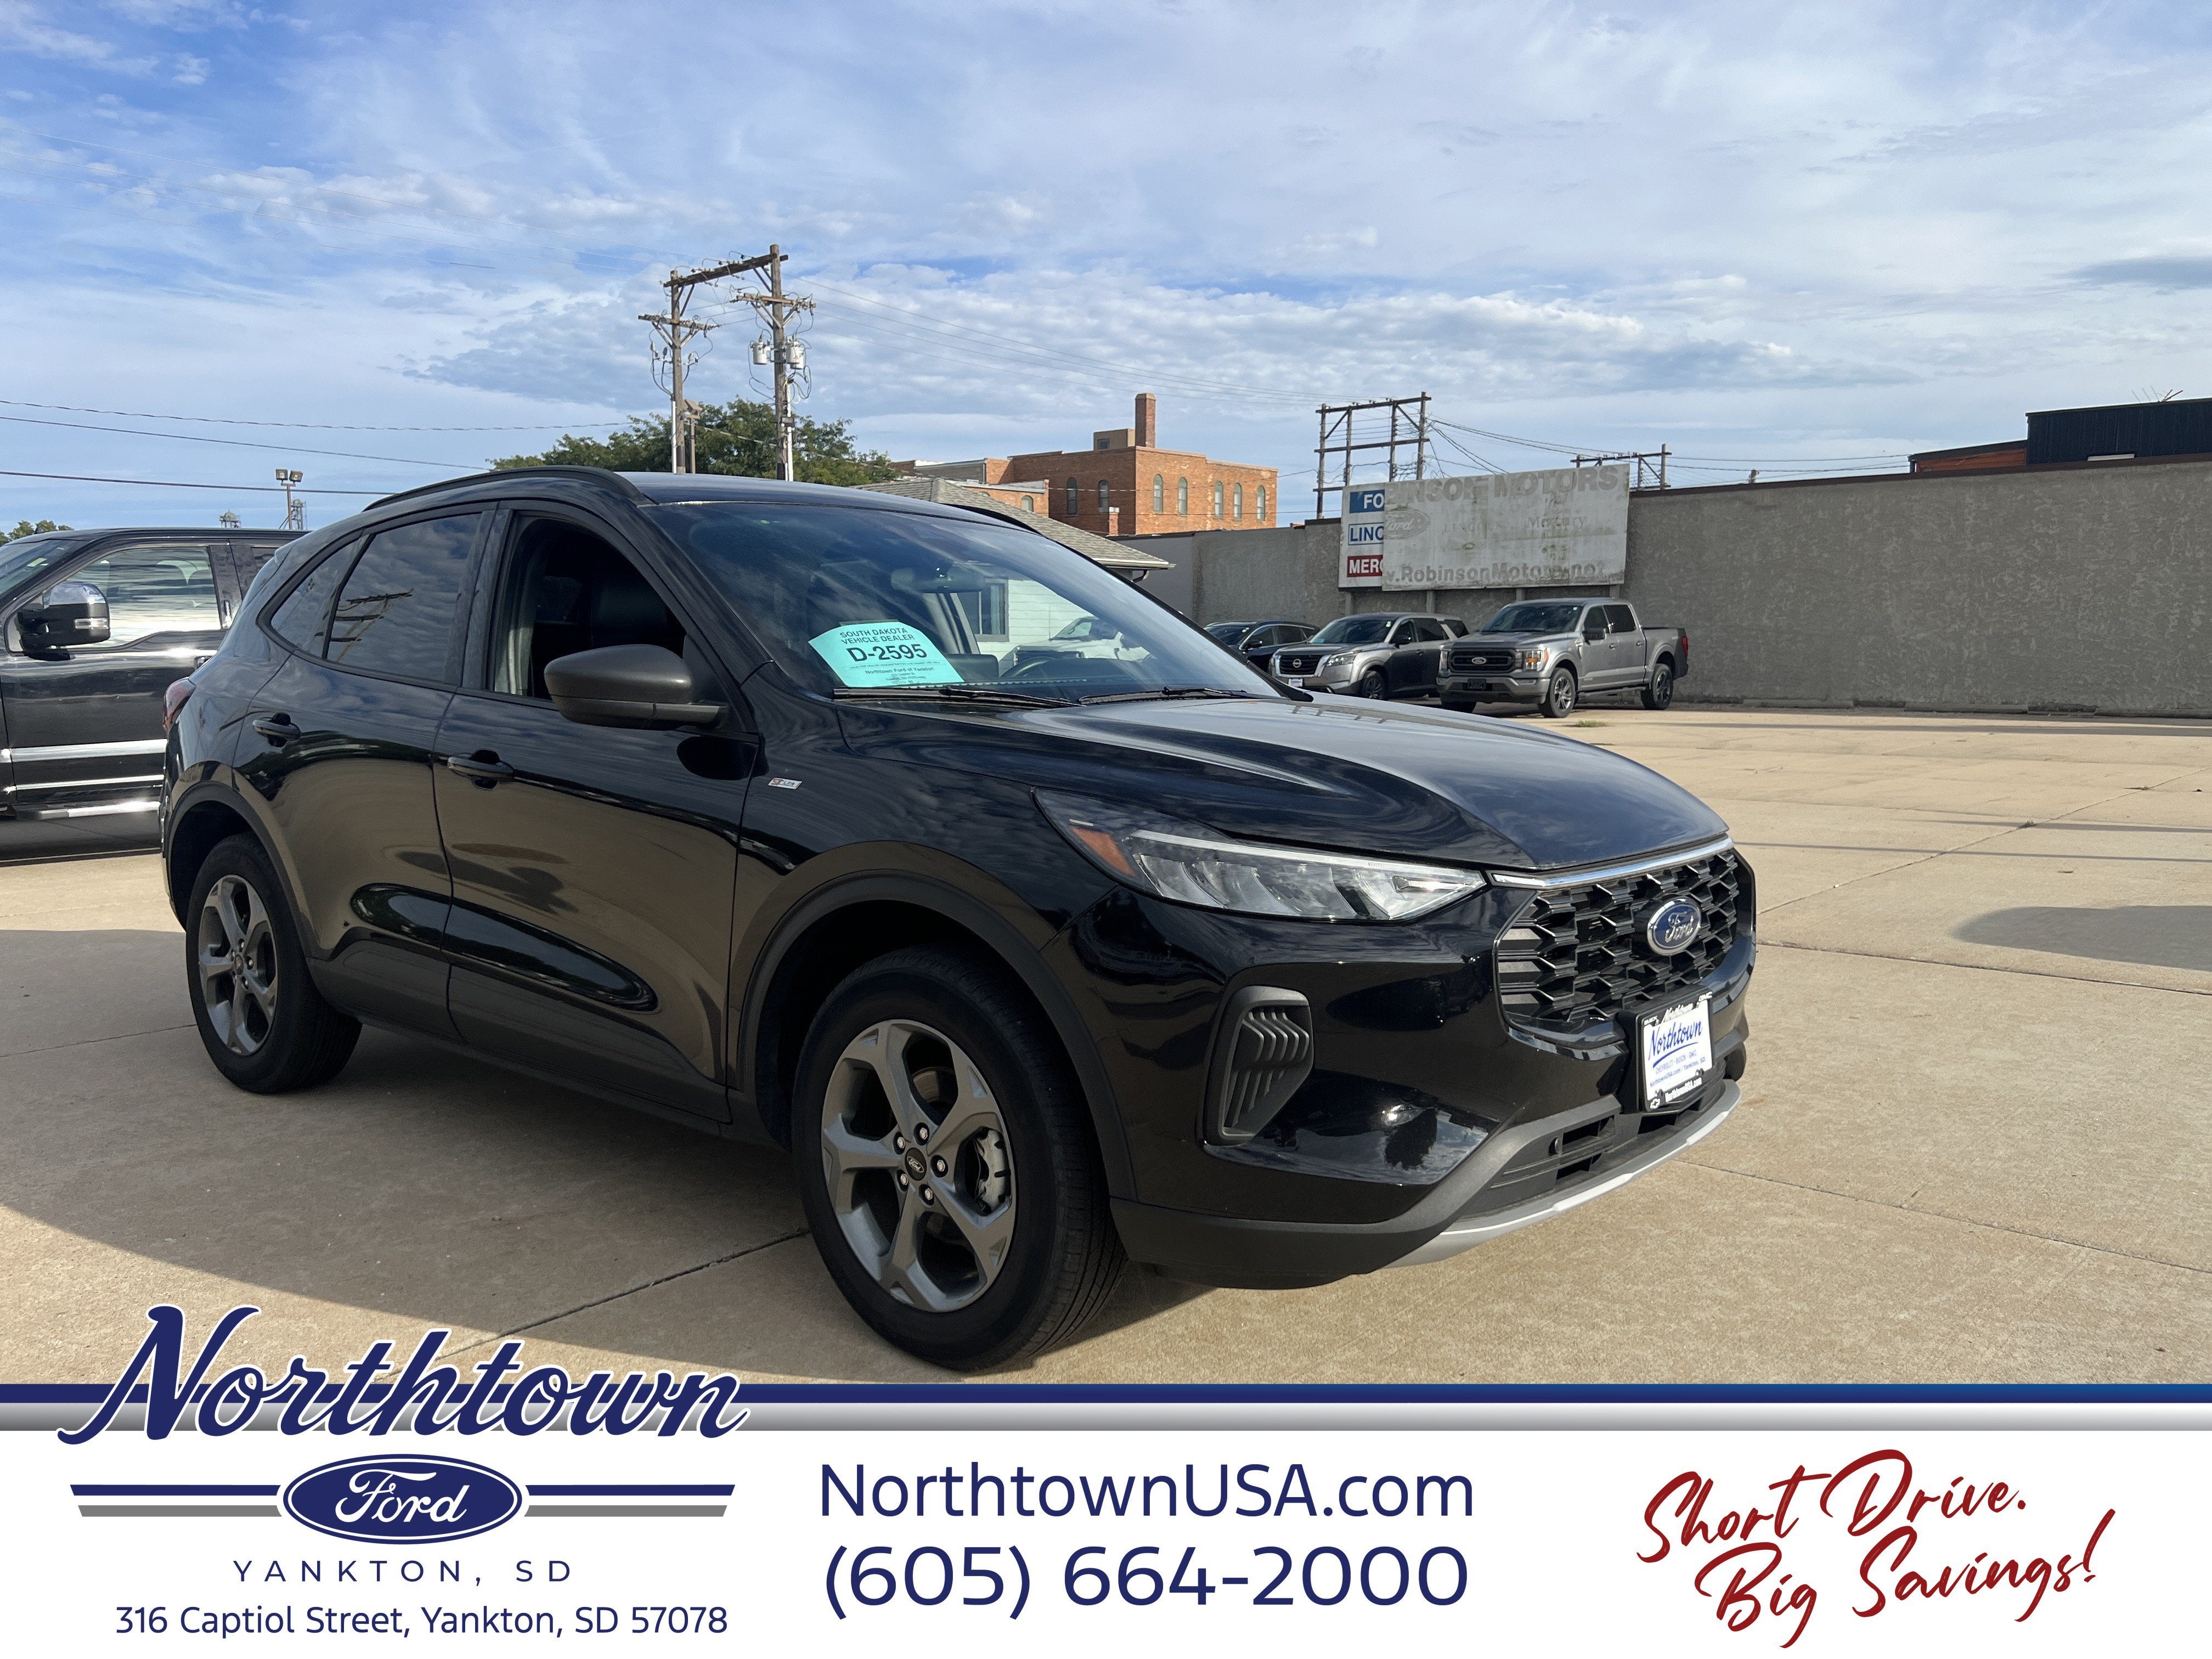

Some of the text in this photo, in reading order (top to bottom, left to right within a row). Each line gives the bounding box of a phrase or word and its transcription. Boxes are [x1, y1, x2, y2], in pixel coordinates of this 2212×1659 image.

[1494, 466, 1618, 498] MOTORS
[841, 635, 878, 645] VEHICLE
[846, 644, 927, 662] D-2595
[1665, 911, 1694, 943] Ford
[1649, 1021, 1702, 1060] Northtown
